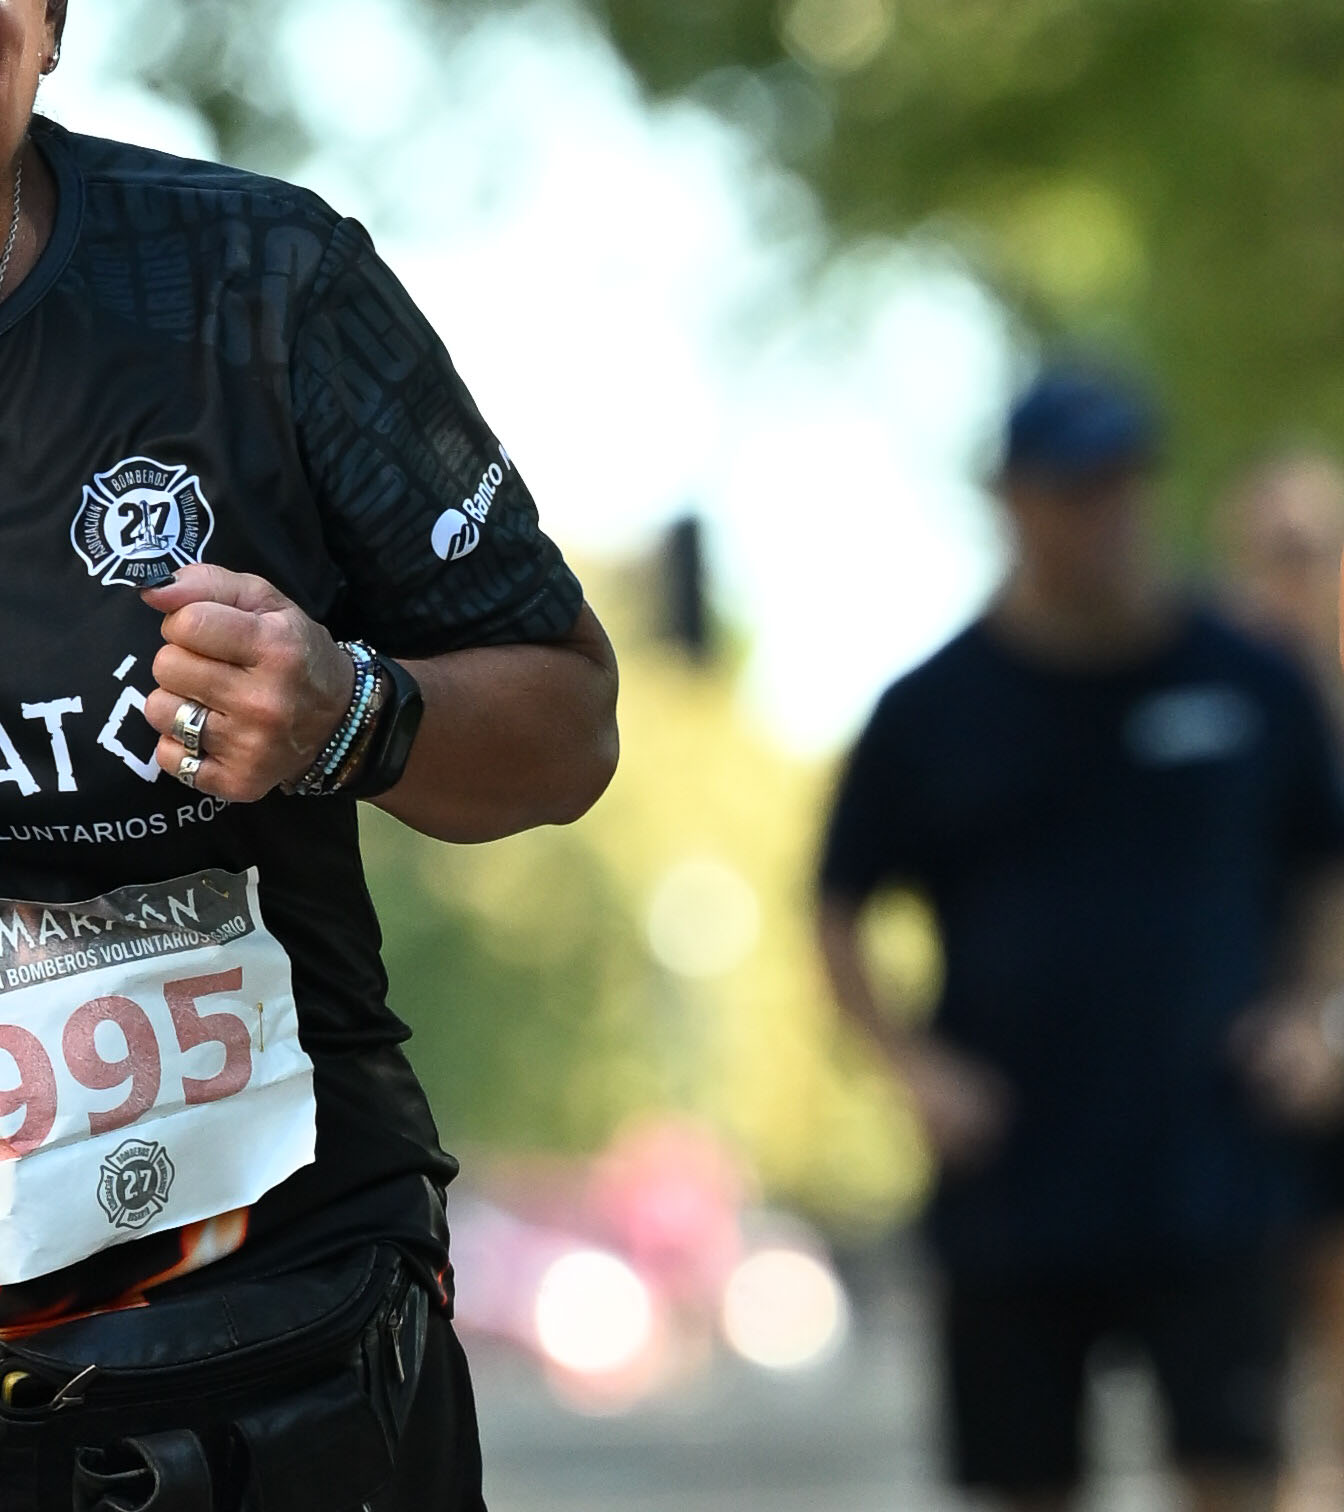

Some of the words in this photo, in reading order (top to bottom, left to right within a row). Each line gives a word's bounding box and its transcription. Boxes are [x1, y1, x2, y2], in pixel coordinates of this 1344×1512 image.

[111, 469, 169, 492] BOMBEROS
[462, 462, 503, 524] Banco
[118, 500, 171, 548] 27
[125, 561, 171, 578] ROSARIO
[6, 950, 98, 987] BOMBEROS
[0, 966, 252, 1161] 995
[122, 1170, 152, 1201] 27
